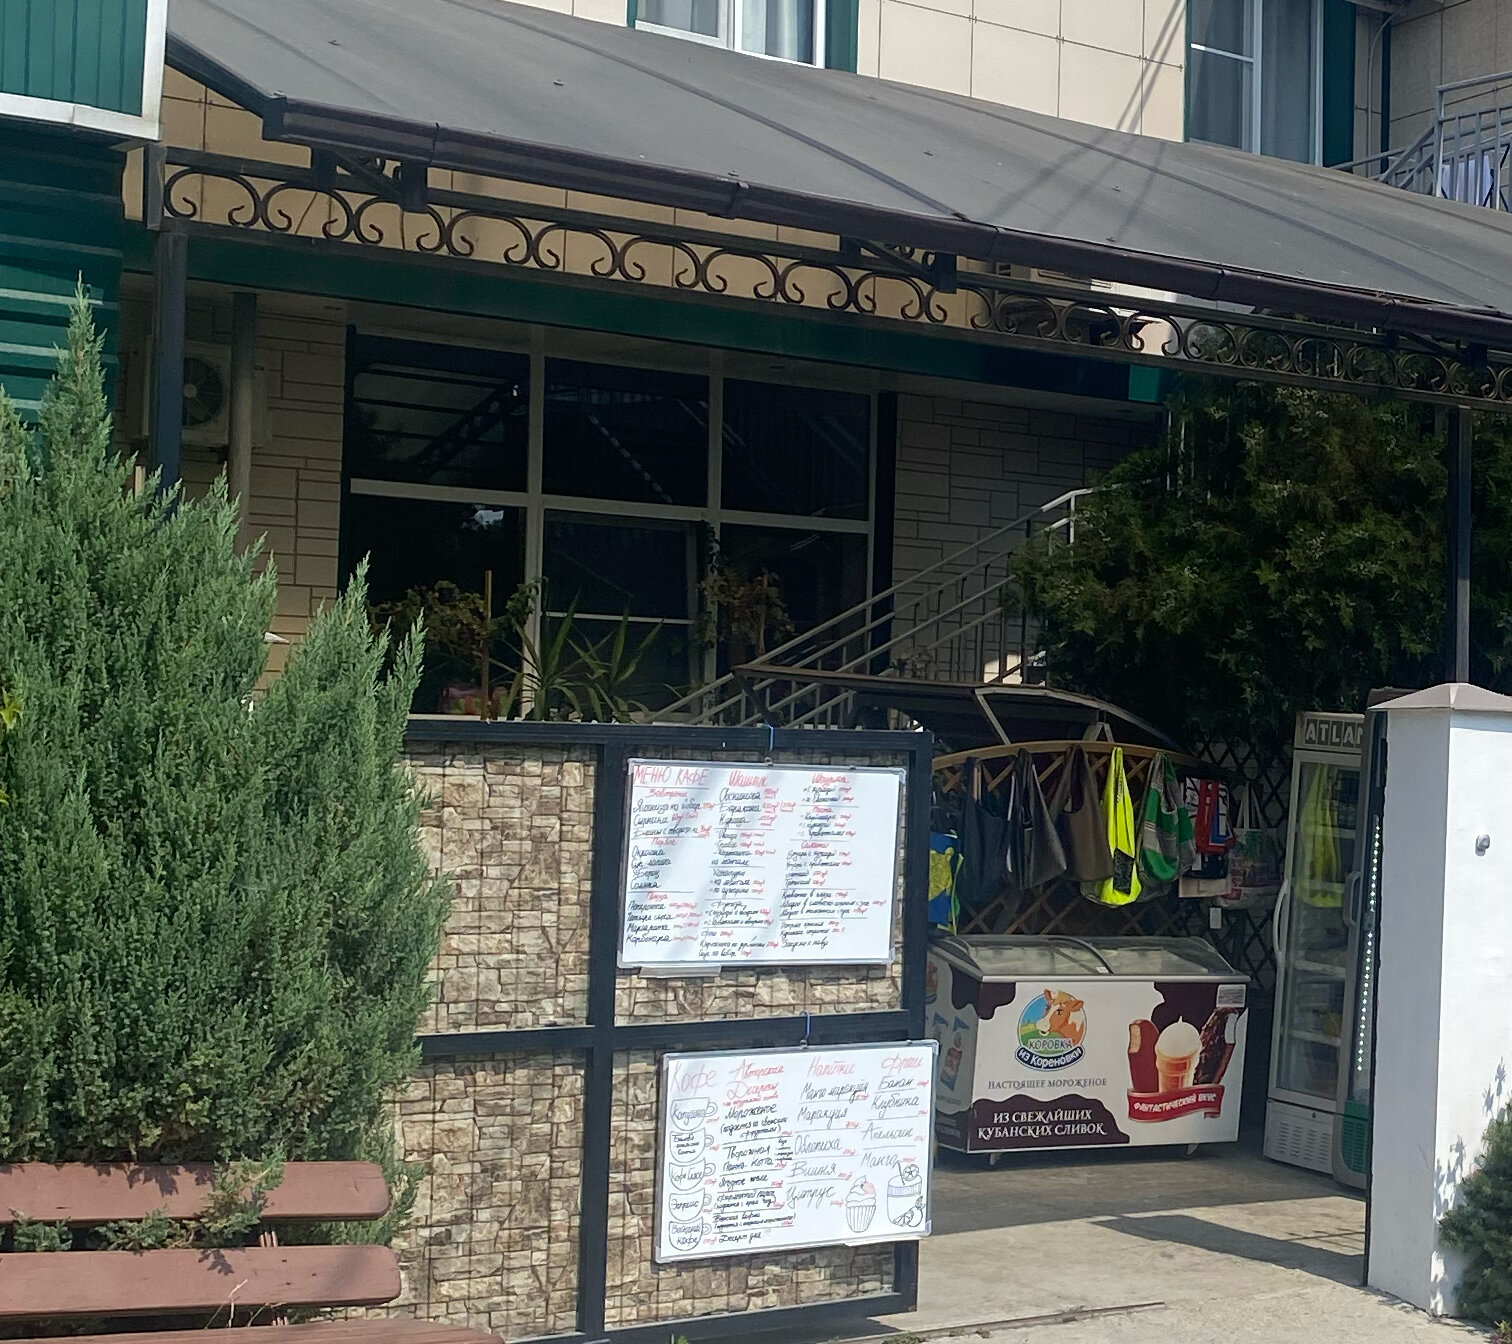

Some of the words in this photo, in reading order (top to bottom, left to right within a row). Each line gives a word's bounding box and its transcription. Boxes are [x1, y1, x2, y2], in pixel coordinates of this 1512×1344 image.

[633, 765, 672, 785] МЕНЮ
[675, 767, 709, 786] КАФЕ
[1028, 1039, 1073, 1050] КОРОВКА
[670, 1061, 718, 1096] Кофе
[988, 1079, 1045, 1091] НАСТОЯЩЕЕ
[1047, 1077, 1107, 1089] МОРОЖЕНОЕ
[993, 1112, 1010, 1124] ИЗ
[1012, 1108, 1093, 1124] СВЕЖАЙШИХ
[978, 1124, 1053, 1141] КУБАНСКИХ
[1054, 1122, 1108, 1136] СЛИВОК
[795, 1135, 842, 1155] Облепиха
[786, 1161, 837, 1178] Вишня
[786, 1186, 835, 1210] Цитрус
